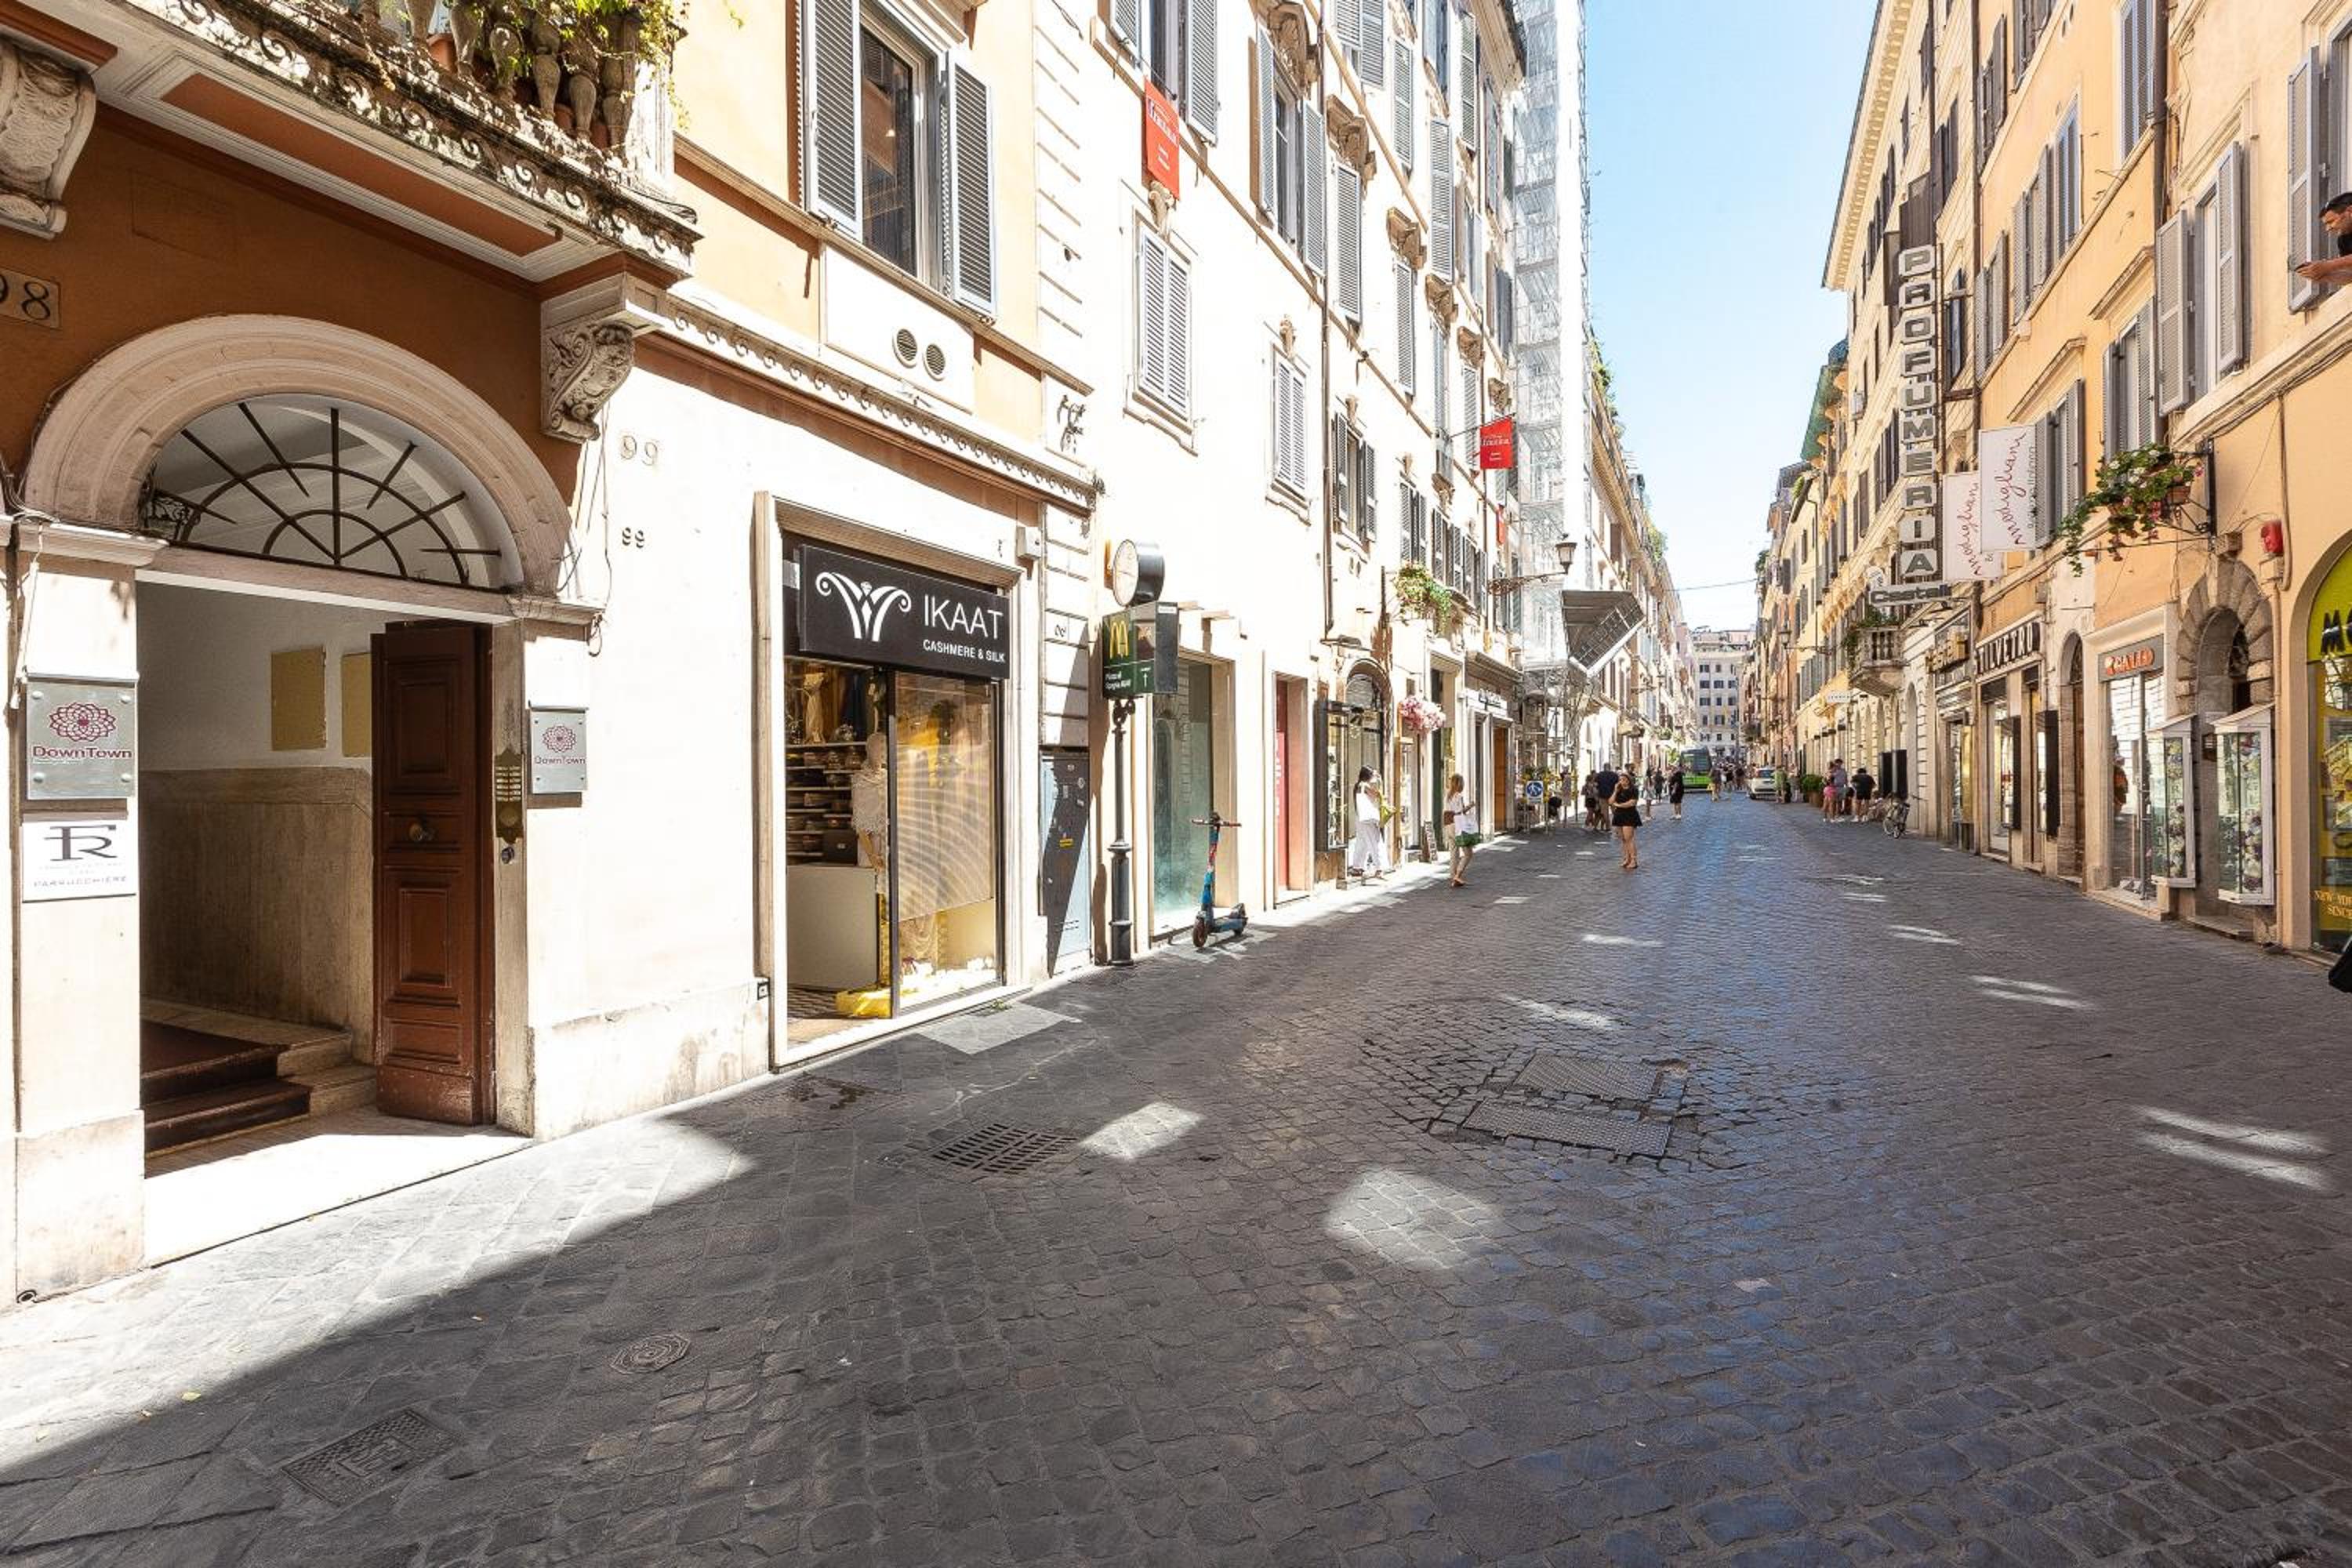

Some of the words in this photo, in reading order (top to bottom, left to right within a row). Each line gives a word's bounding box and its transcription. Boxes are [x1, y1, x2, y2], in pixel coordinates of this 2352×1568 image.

[1904, 249, 1935, 575] PROFUMERIA
[620, 434, 659, 466] 99
[924, 593, 1004, 640] IKAAT
[923, 639, 976, 659] CASHMERE
[978, 649, 985, 660] &
[985, 650, 1006, 663] SILK
[33, 746, 132, 759] DownTown
[535, 754, 586, 765] DownTown
